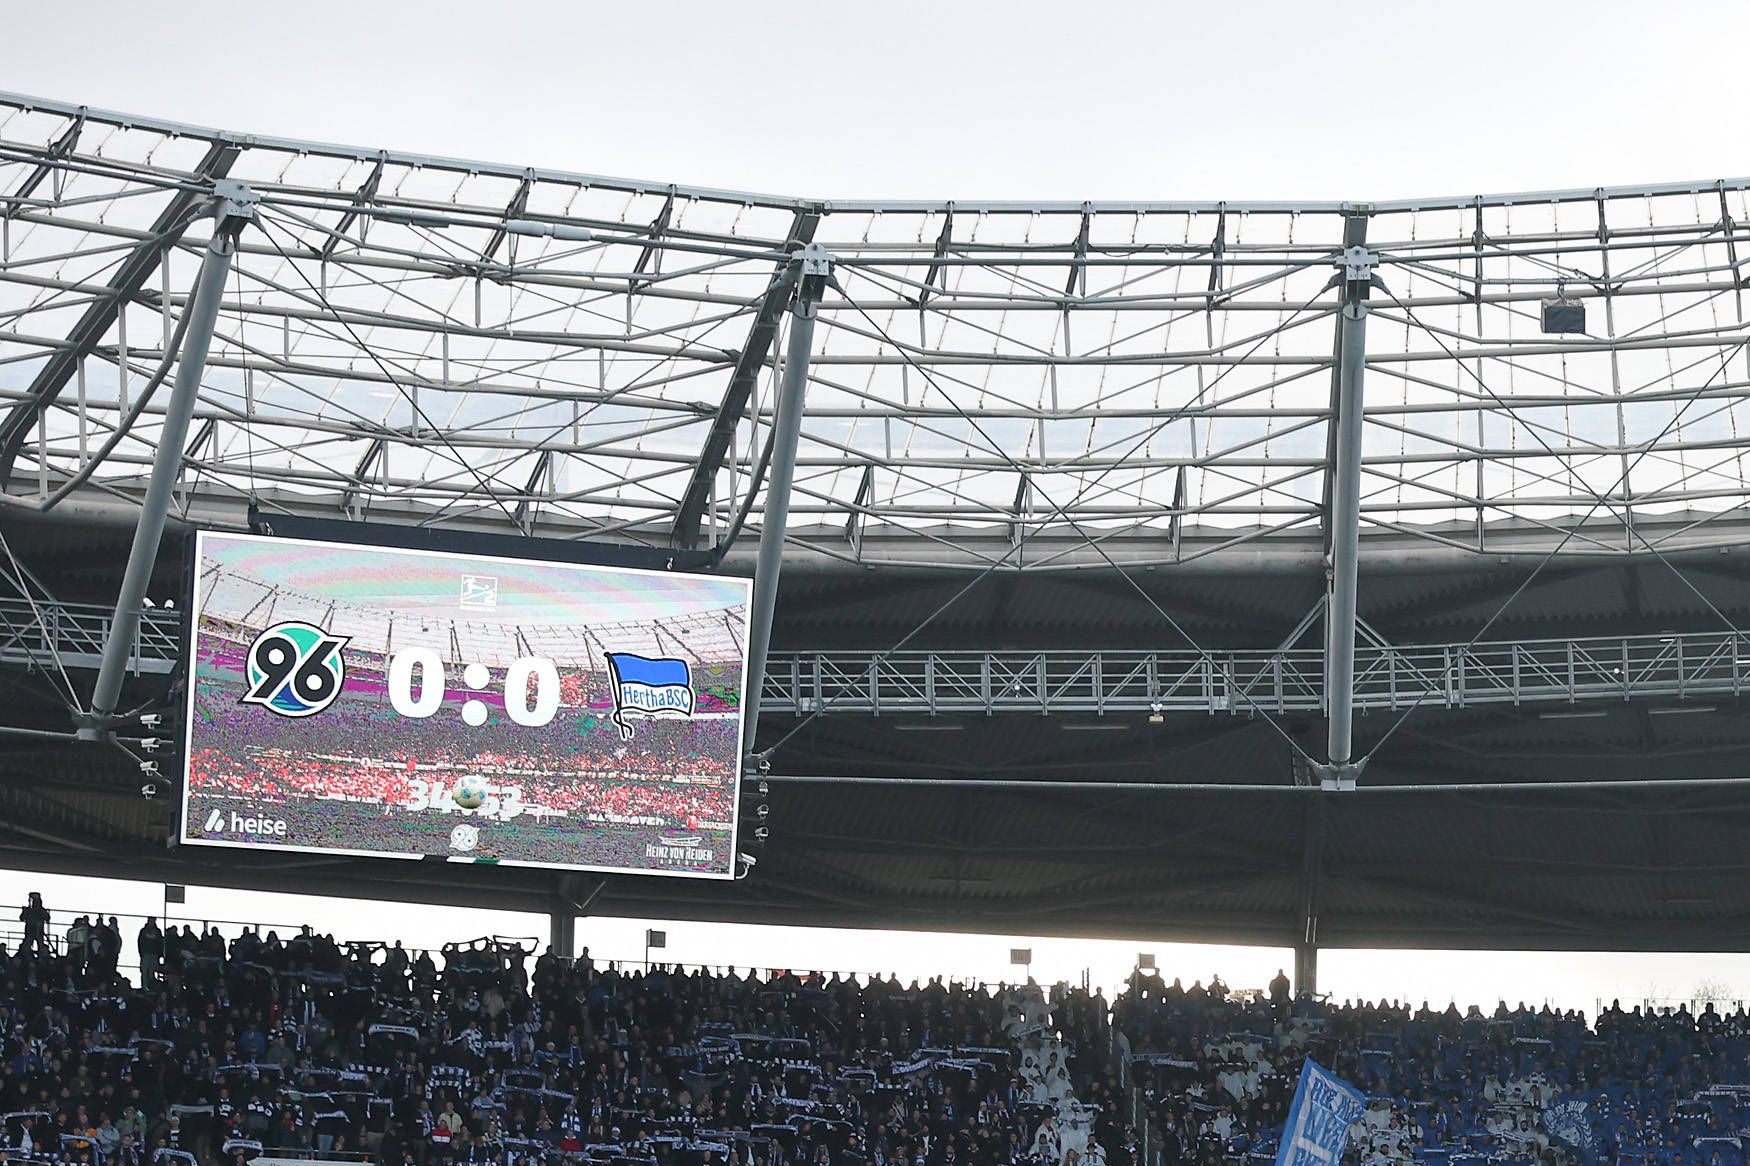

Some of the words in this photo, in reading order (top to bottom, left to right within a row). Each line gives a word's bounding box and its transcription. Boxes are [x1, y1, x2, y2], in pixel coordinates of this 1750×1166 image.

[667, 688, 689, 709] BSC
[231, 811, 288, 836] heise
[646, 844, 670, 859] HEINZ
